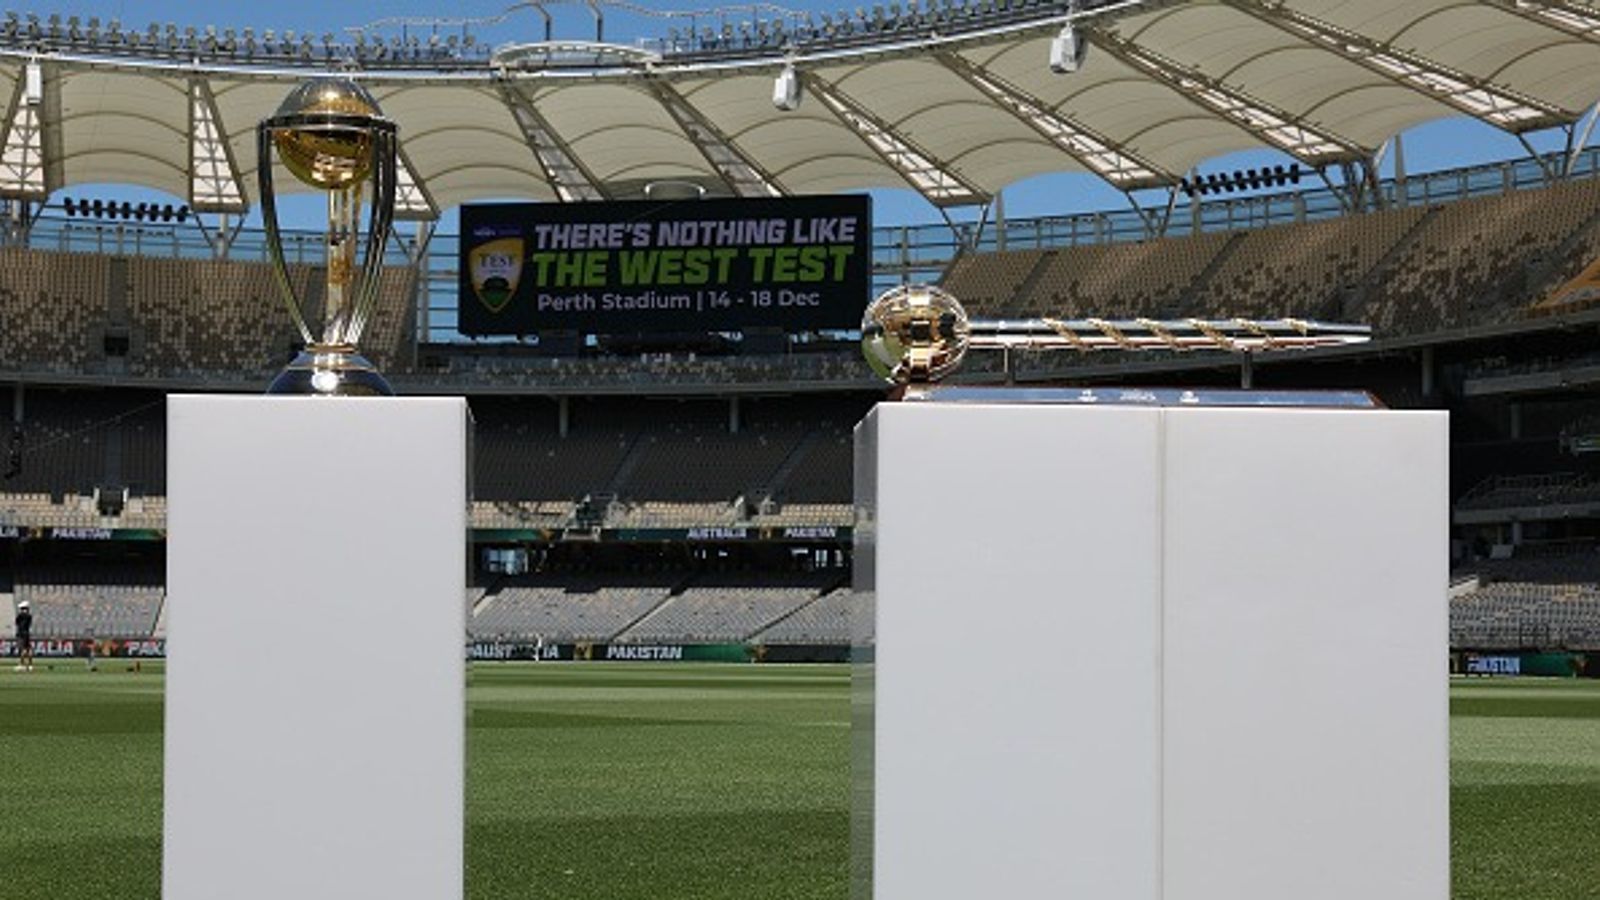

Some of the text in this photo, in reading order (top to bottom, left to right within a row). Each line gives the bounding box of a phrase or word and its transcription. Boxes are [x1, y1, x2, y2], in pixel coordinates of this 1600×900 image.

[535, 217, 857, 249] THERE'S NOTHING LIKE
[532, 245, 855, 288] THE WEST TEST
[538, 293, 595, 312] Perth
[602, 291, 690, 311] Stadium
[708, 291, 730, 308] 14
[749, 290, 772, 308] 18
[778, 289, 820, 308] Dec
[607, 646, 682, 659] PAKISTAN
